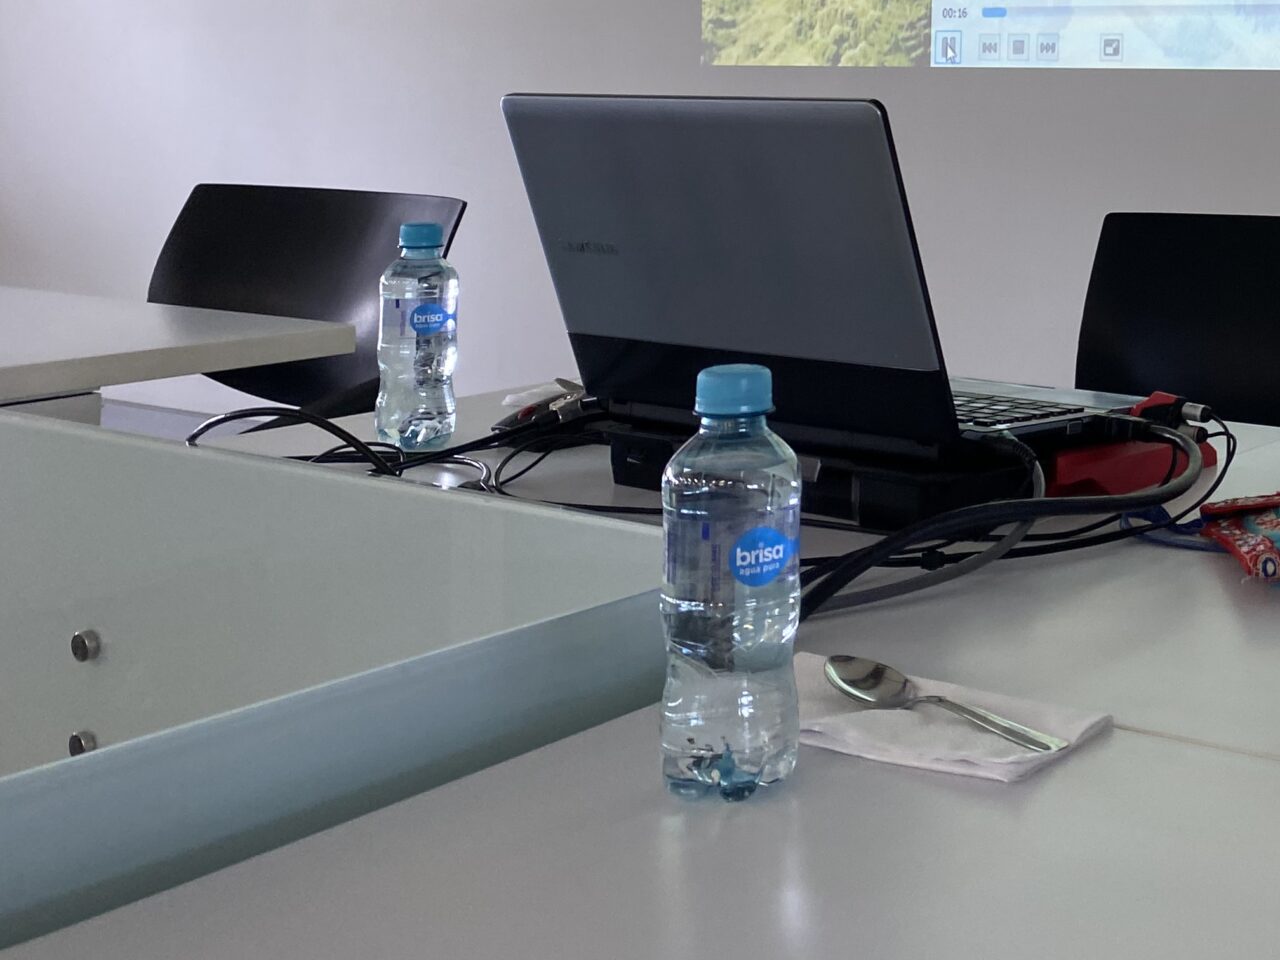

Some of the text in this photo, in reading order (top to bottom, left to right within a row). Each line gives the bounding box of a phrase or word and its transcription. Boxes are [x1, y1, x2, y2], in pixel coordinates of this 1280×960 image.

[942, 7, 968, 19] 00:16
[413, 312, 443, 324] brisa
[736, 542, 784, 567] brisa
